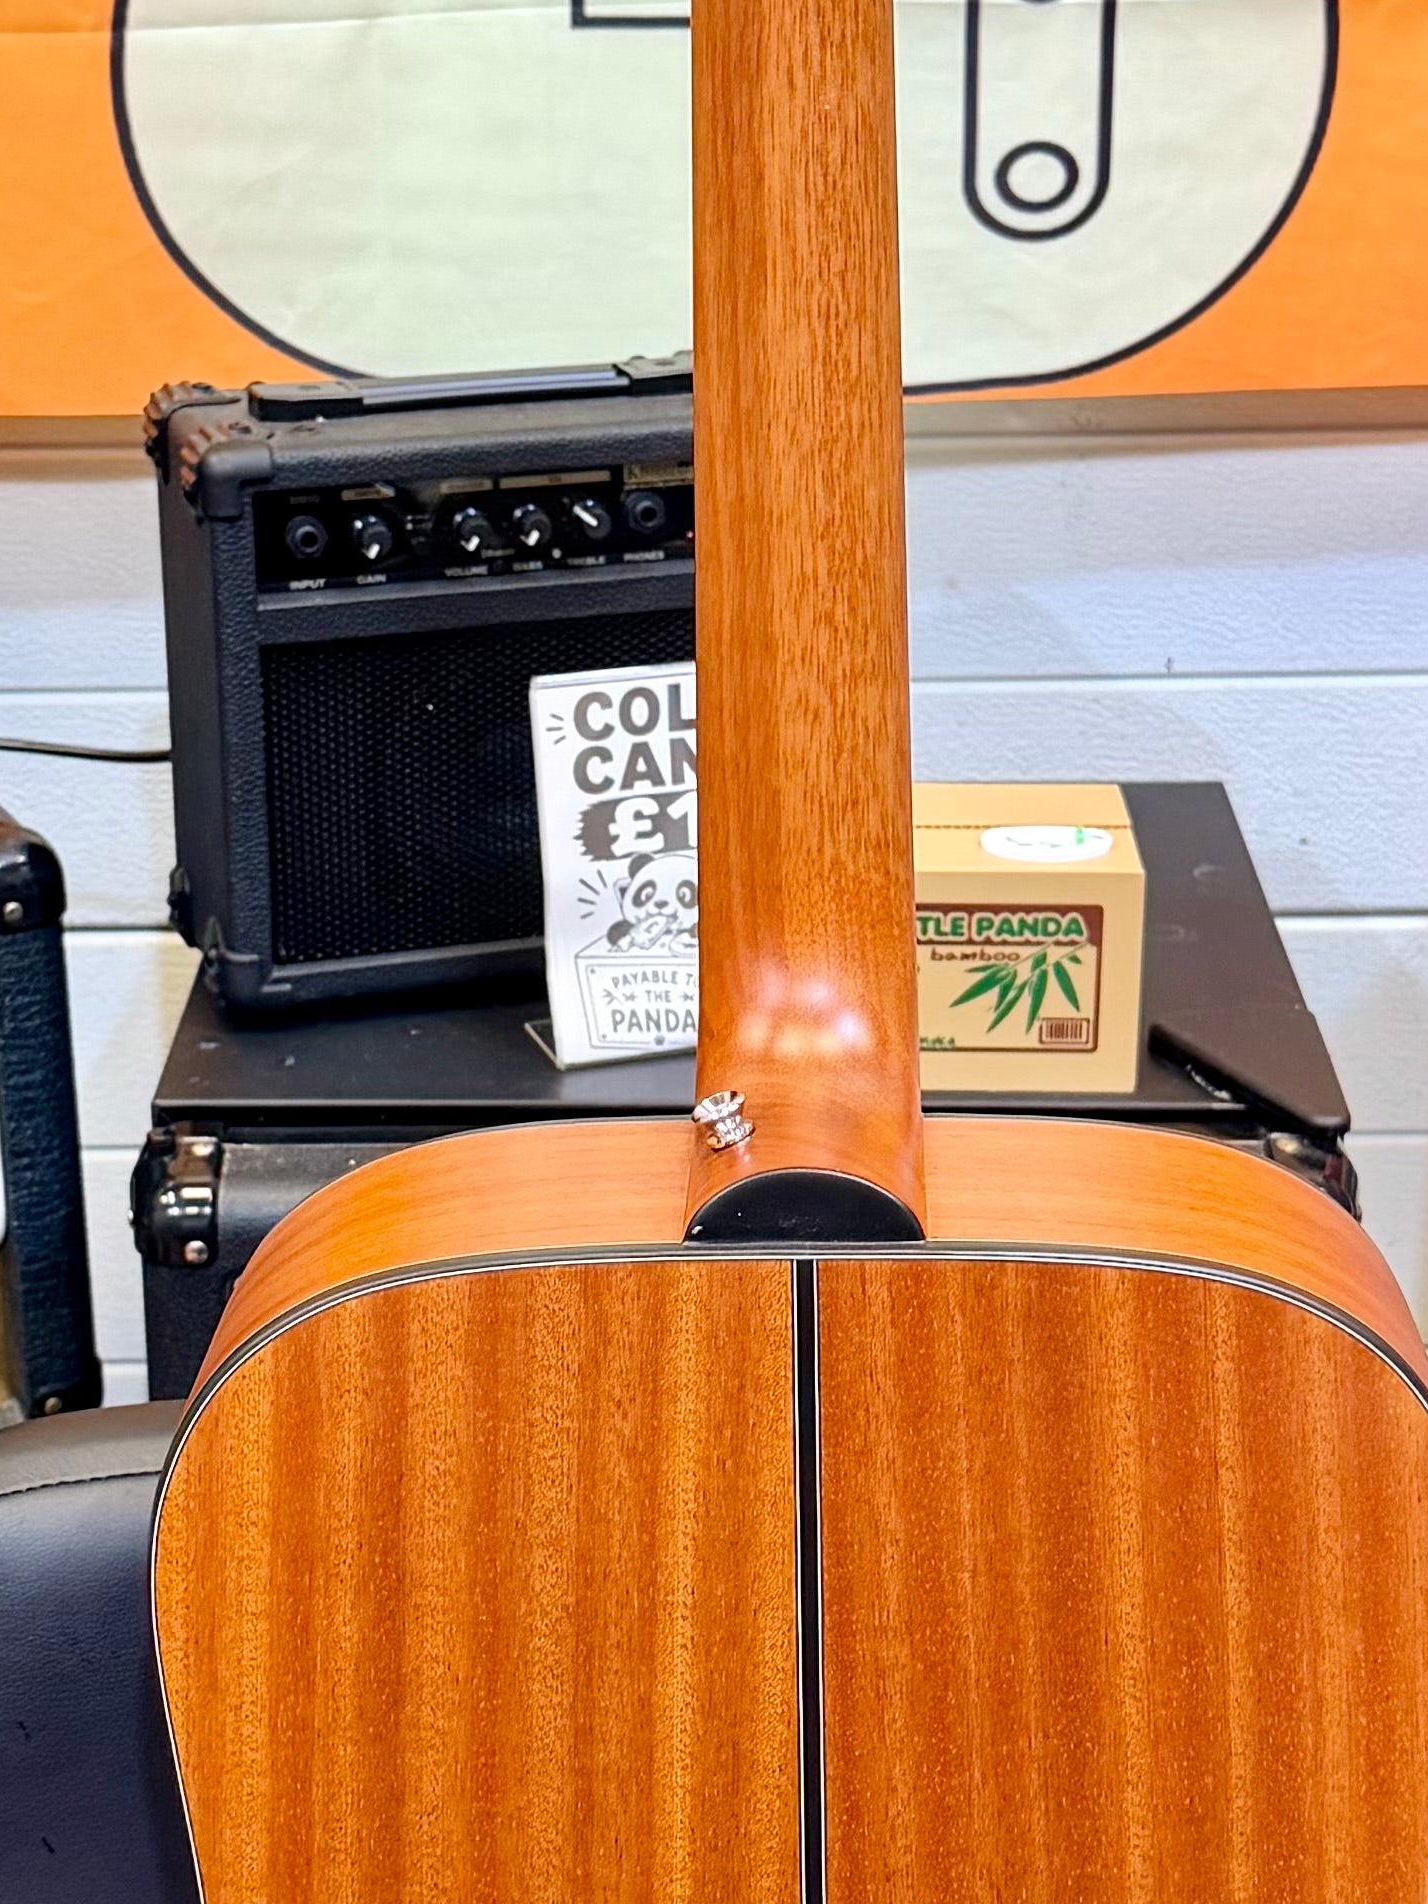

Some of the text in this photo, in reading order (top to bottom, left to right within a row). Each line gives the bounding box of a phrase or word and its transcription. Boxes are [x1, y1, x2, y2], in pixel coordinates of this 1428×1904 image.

[444, 564, 489, 577] VOLUME
[289, 577, 327, 590] INPUT
[975, 916, 1086, 938] PANDA
[930, 947, 1021, 963] bamboo
[611, 969, 678, 988] PAYABLE
[644, 989, 672, 1004] THE
[611, 1008, 697, 1034] PANDA
